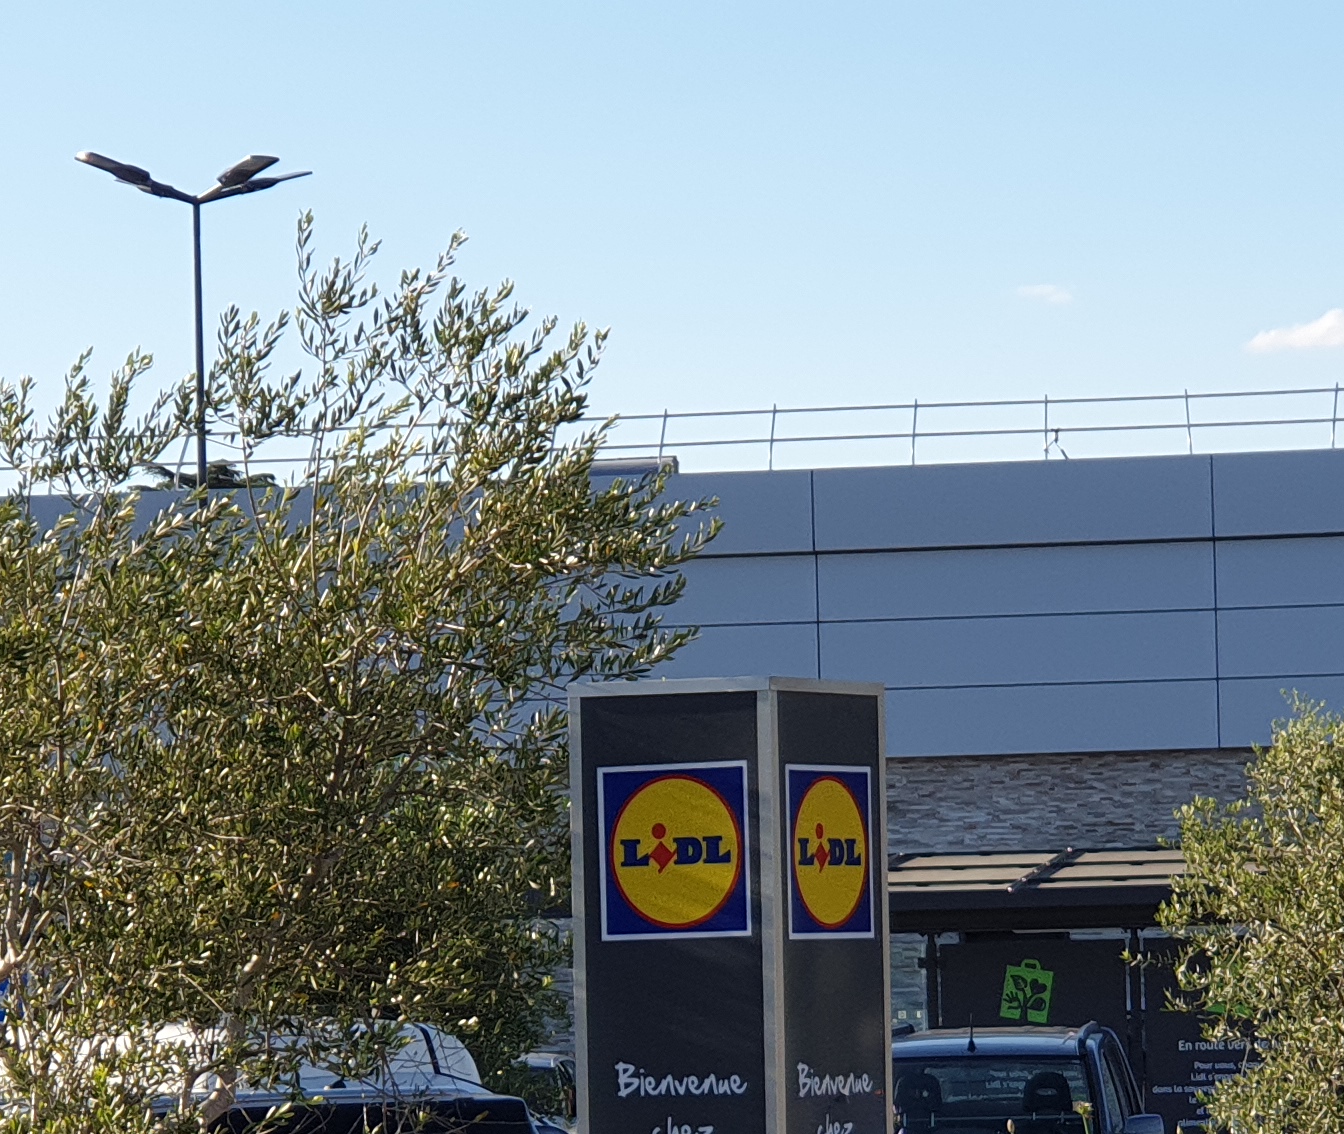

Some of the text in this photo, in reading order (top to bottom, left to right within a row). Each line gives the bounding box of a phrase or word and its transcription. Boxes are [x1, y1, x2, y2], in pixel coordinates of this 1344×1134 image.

[1178, 1040, 1192, 1051] En
[1195, 1040, 1224, 1051] route
[614, 1061, 747, 1098] Bienvenue
[797, 1061, 873, 1098] Bienvenue
